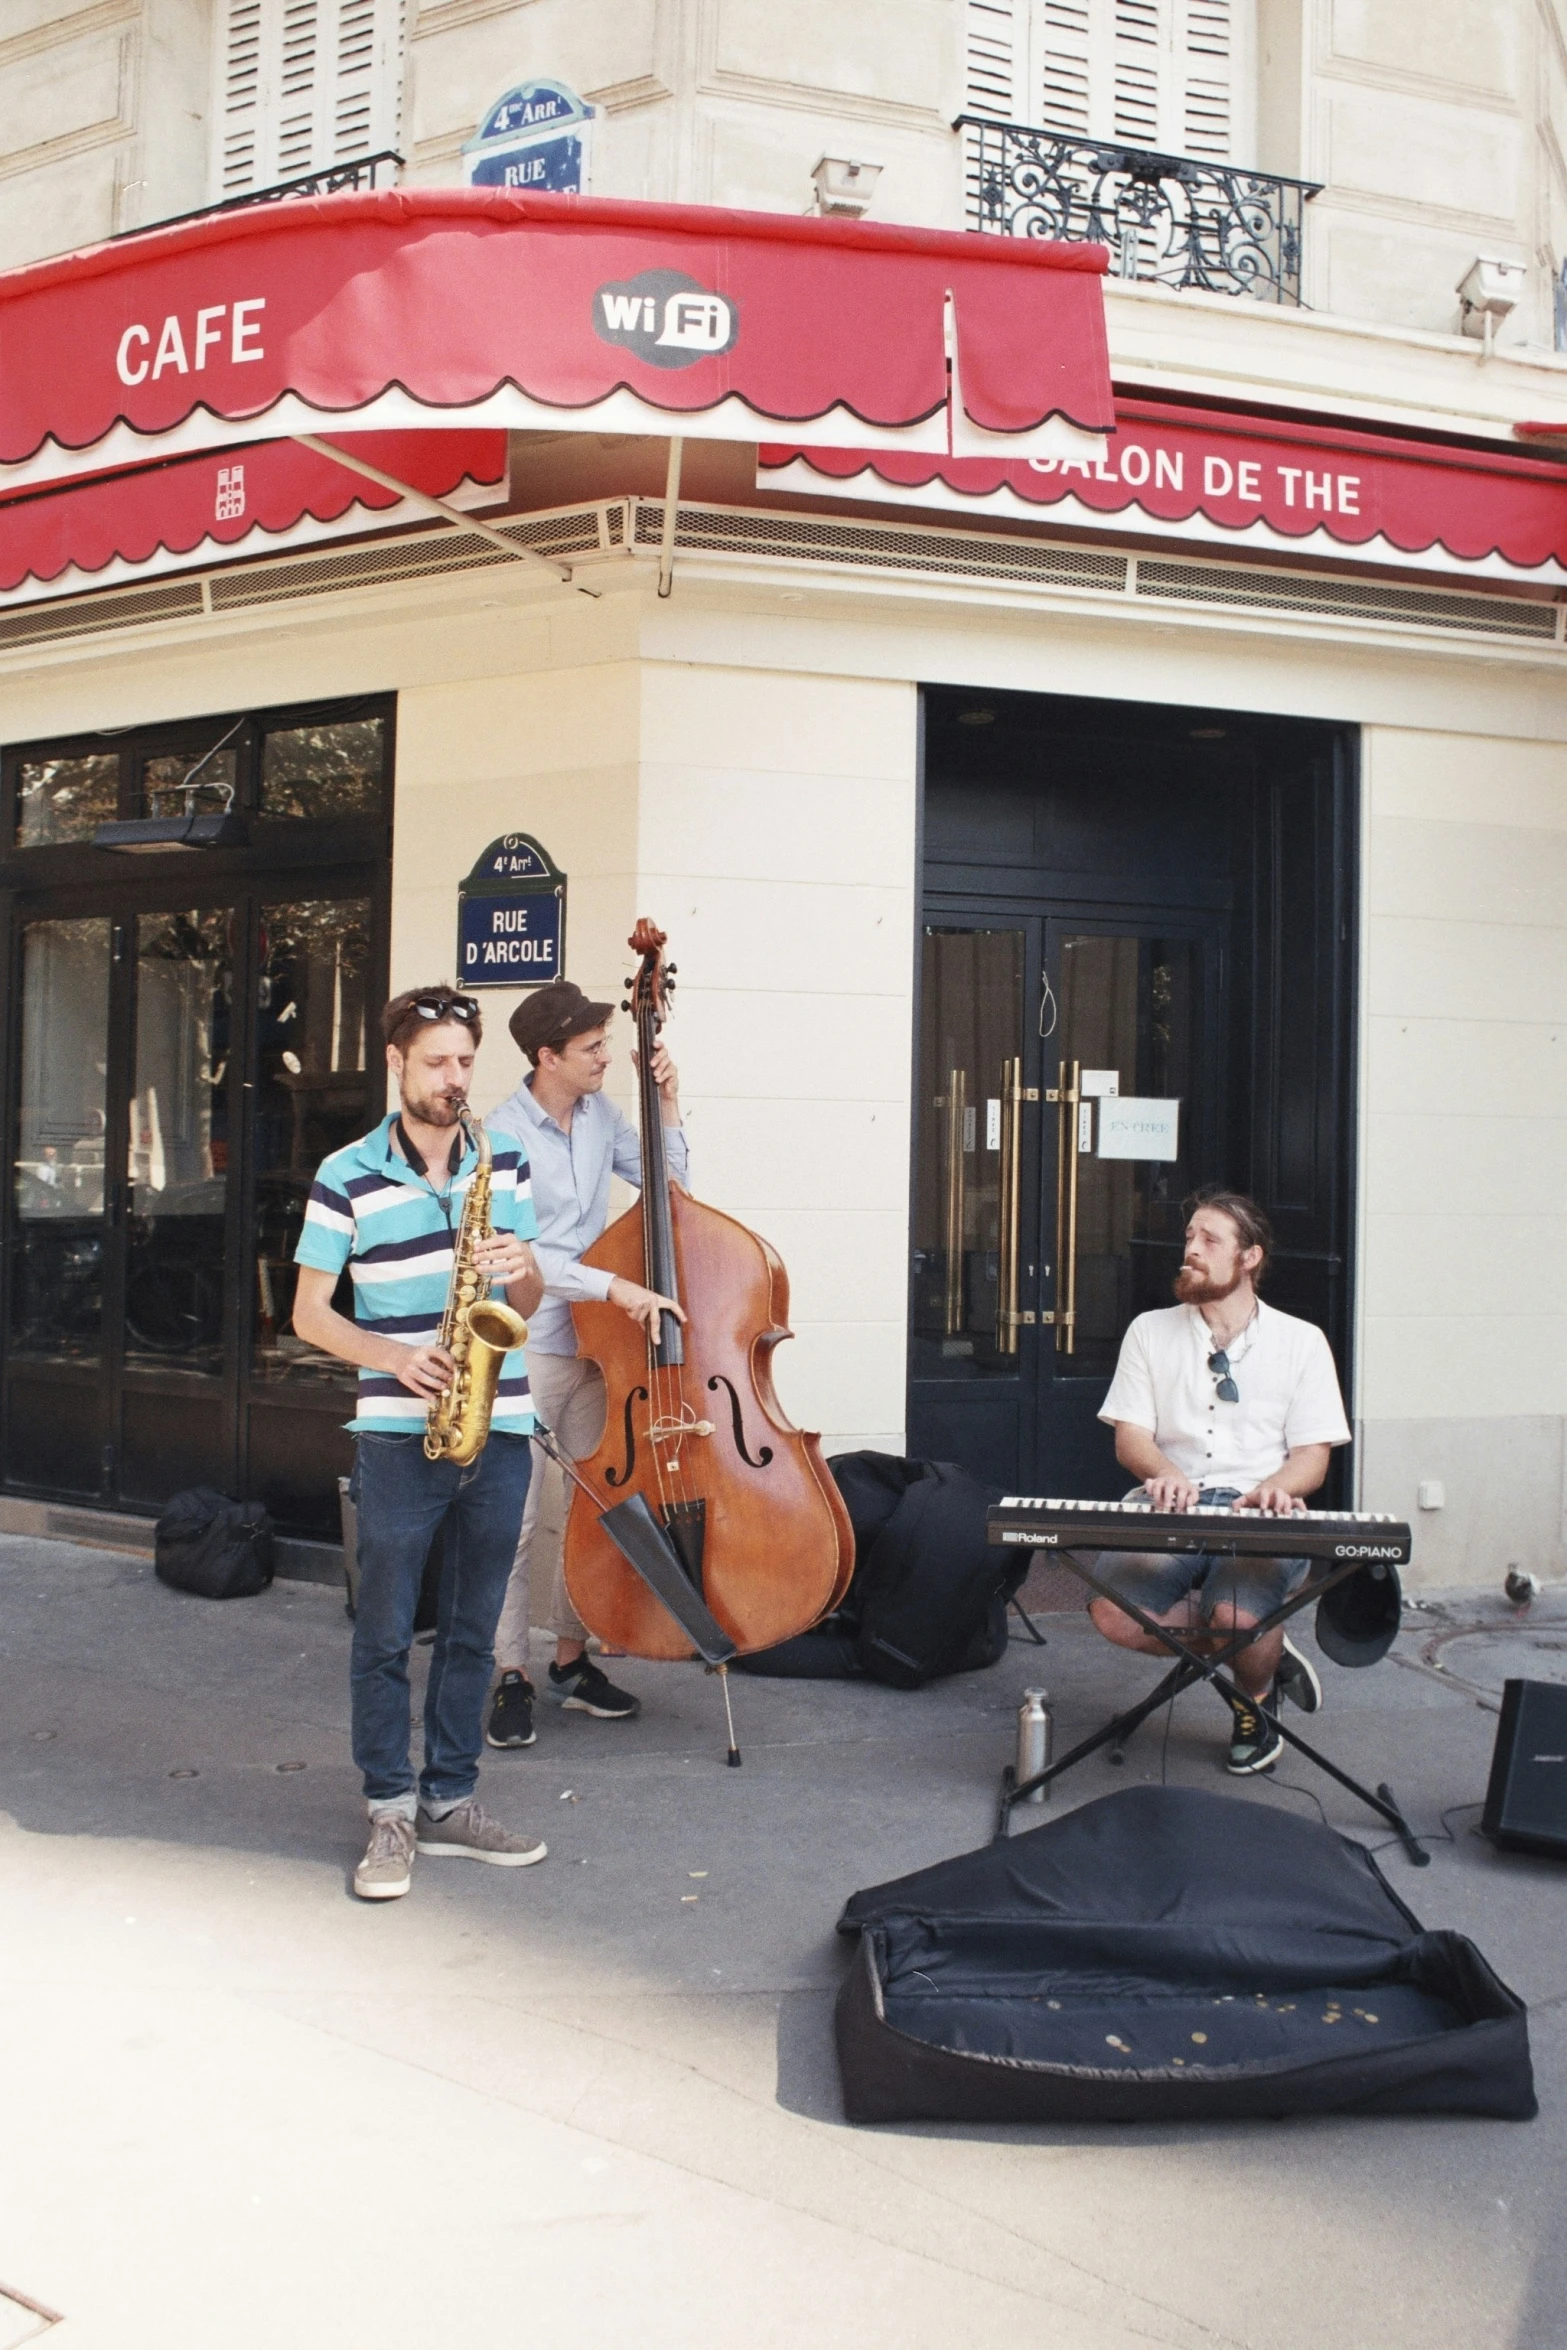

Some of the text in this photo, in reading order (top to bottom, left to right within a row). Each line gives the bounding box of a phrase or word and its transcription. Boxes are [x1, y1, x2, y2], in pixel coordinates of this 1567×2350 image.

[505, 158, 546, 187] RUE
[116, 297, 266, 386] CAFE
[1203, 455, 1262, 502] DE
[1276, 466, 1361, 515] THE
[492, 910, 528, 933] RUE
[1018, 1532, 1058, 1543] Roland
[1335, 1545, 1402, 1559] GO:PIANO
